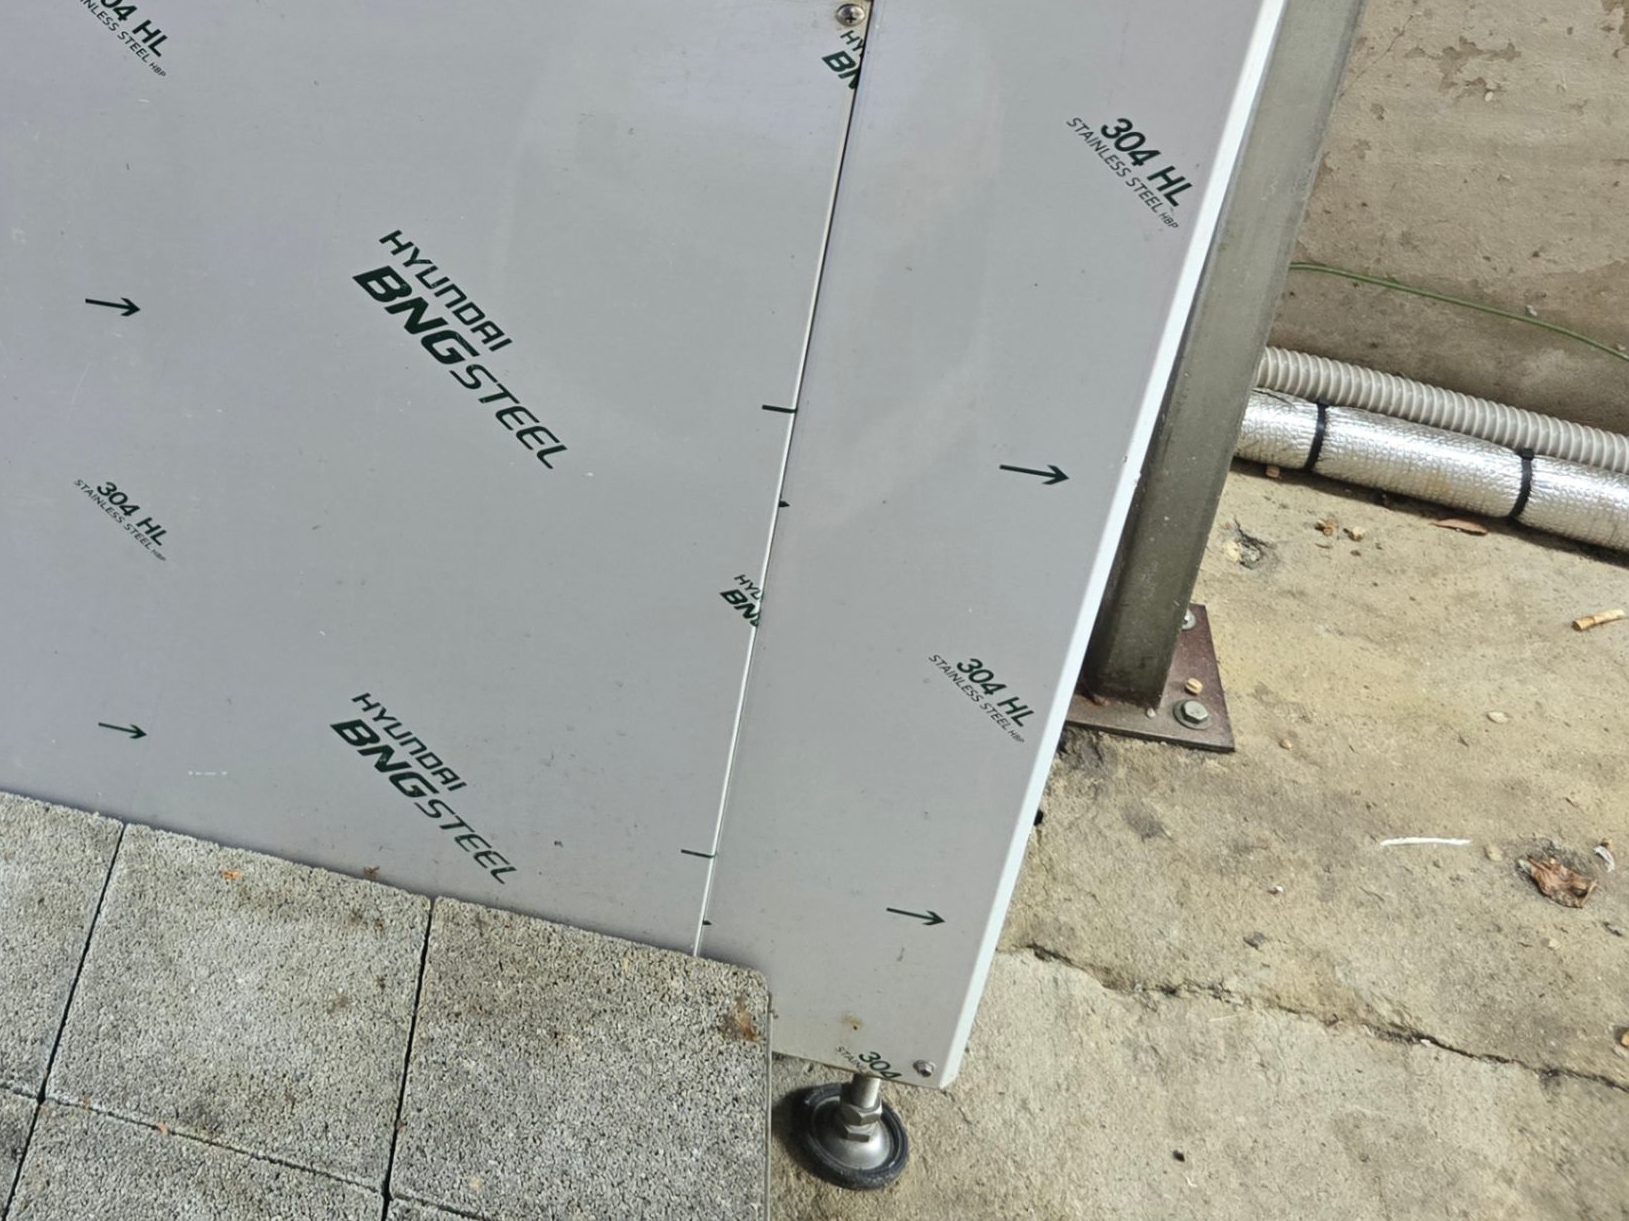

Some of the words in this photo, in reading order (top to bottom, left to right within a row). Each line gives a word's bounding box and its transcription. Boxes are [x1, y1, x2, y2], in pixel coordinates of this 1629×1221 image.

[117, 29, 151, 64] STEEL
[131, 19, 168, 58] HL
[1067, 116, 1131, 184] STAINLESS
[1126, 177, 1166, 214] STEEL
[1100, 118, 1161, 168] 304
[1147, 165, 1196, 208] HL
[379, 229, 513, 352] HYUNDAI
[74, 478, 126, 524] STAINLESS
[122, 521, 154, 552] STEEL
[96, 480, 139, 519] 304
[136, 516, 168, 547] HL
[928, 654, 984, 706] STAINLESS
[979, 702, 1013, 733] STEEL
[955, 658, 1007, 696] 304
[997, 695, 1034, 728] HL
[351, 692, 467, 792] HYUNDAI
